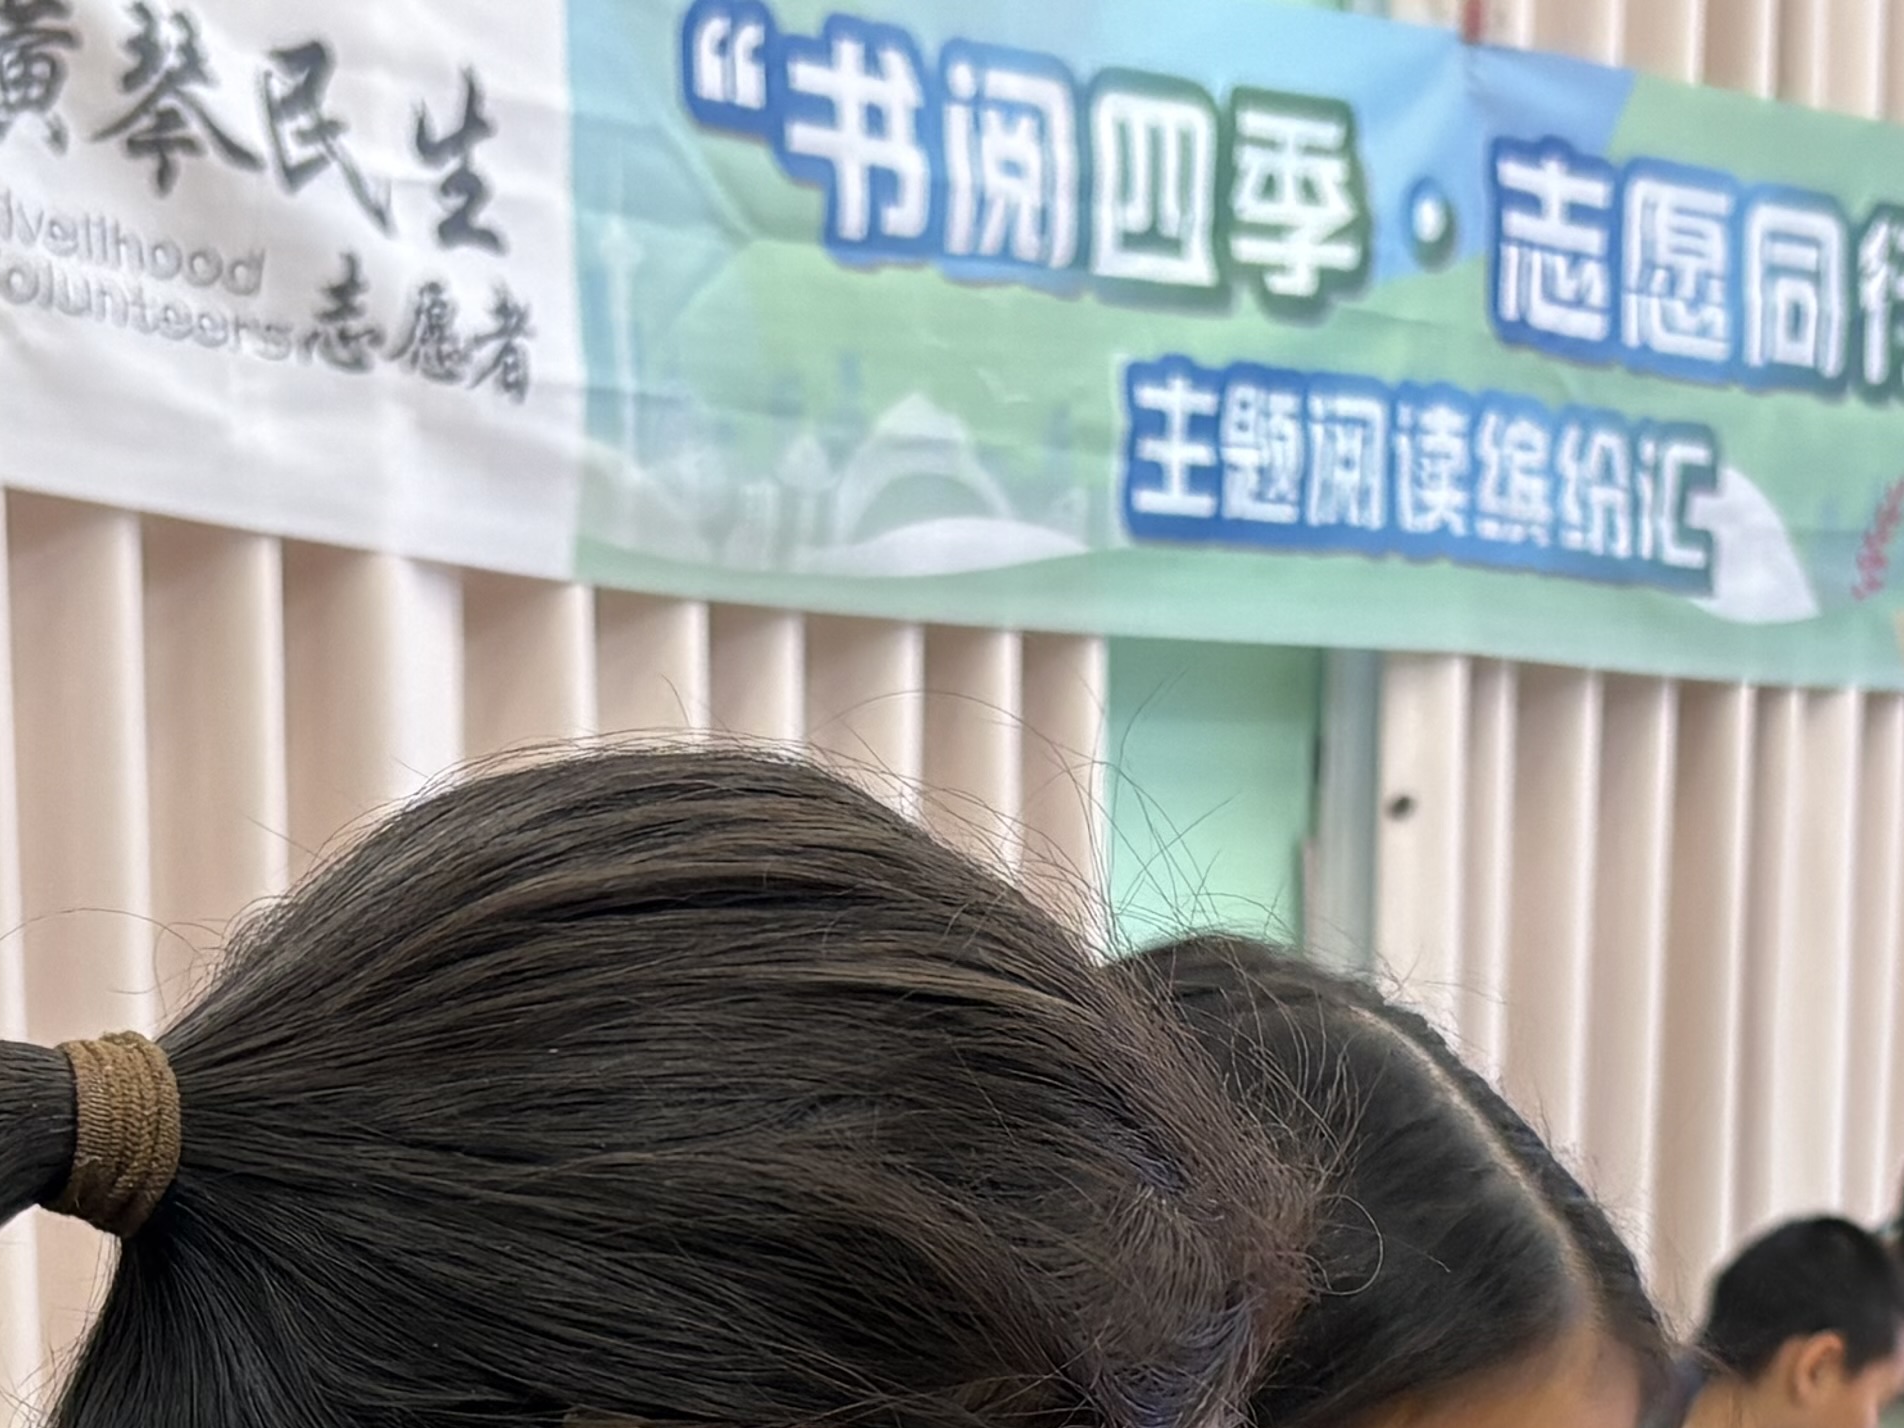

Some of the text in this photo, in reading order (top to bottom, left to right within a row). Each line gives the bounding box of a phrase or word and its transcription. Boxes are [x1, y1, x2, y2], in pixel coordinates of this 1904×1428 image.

[304, 250, 537, 405] 志愿者
[1132, 378, 1711, 570] 主题阅读缤纷汇
